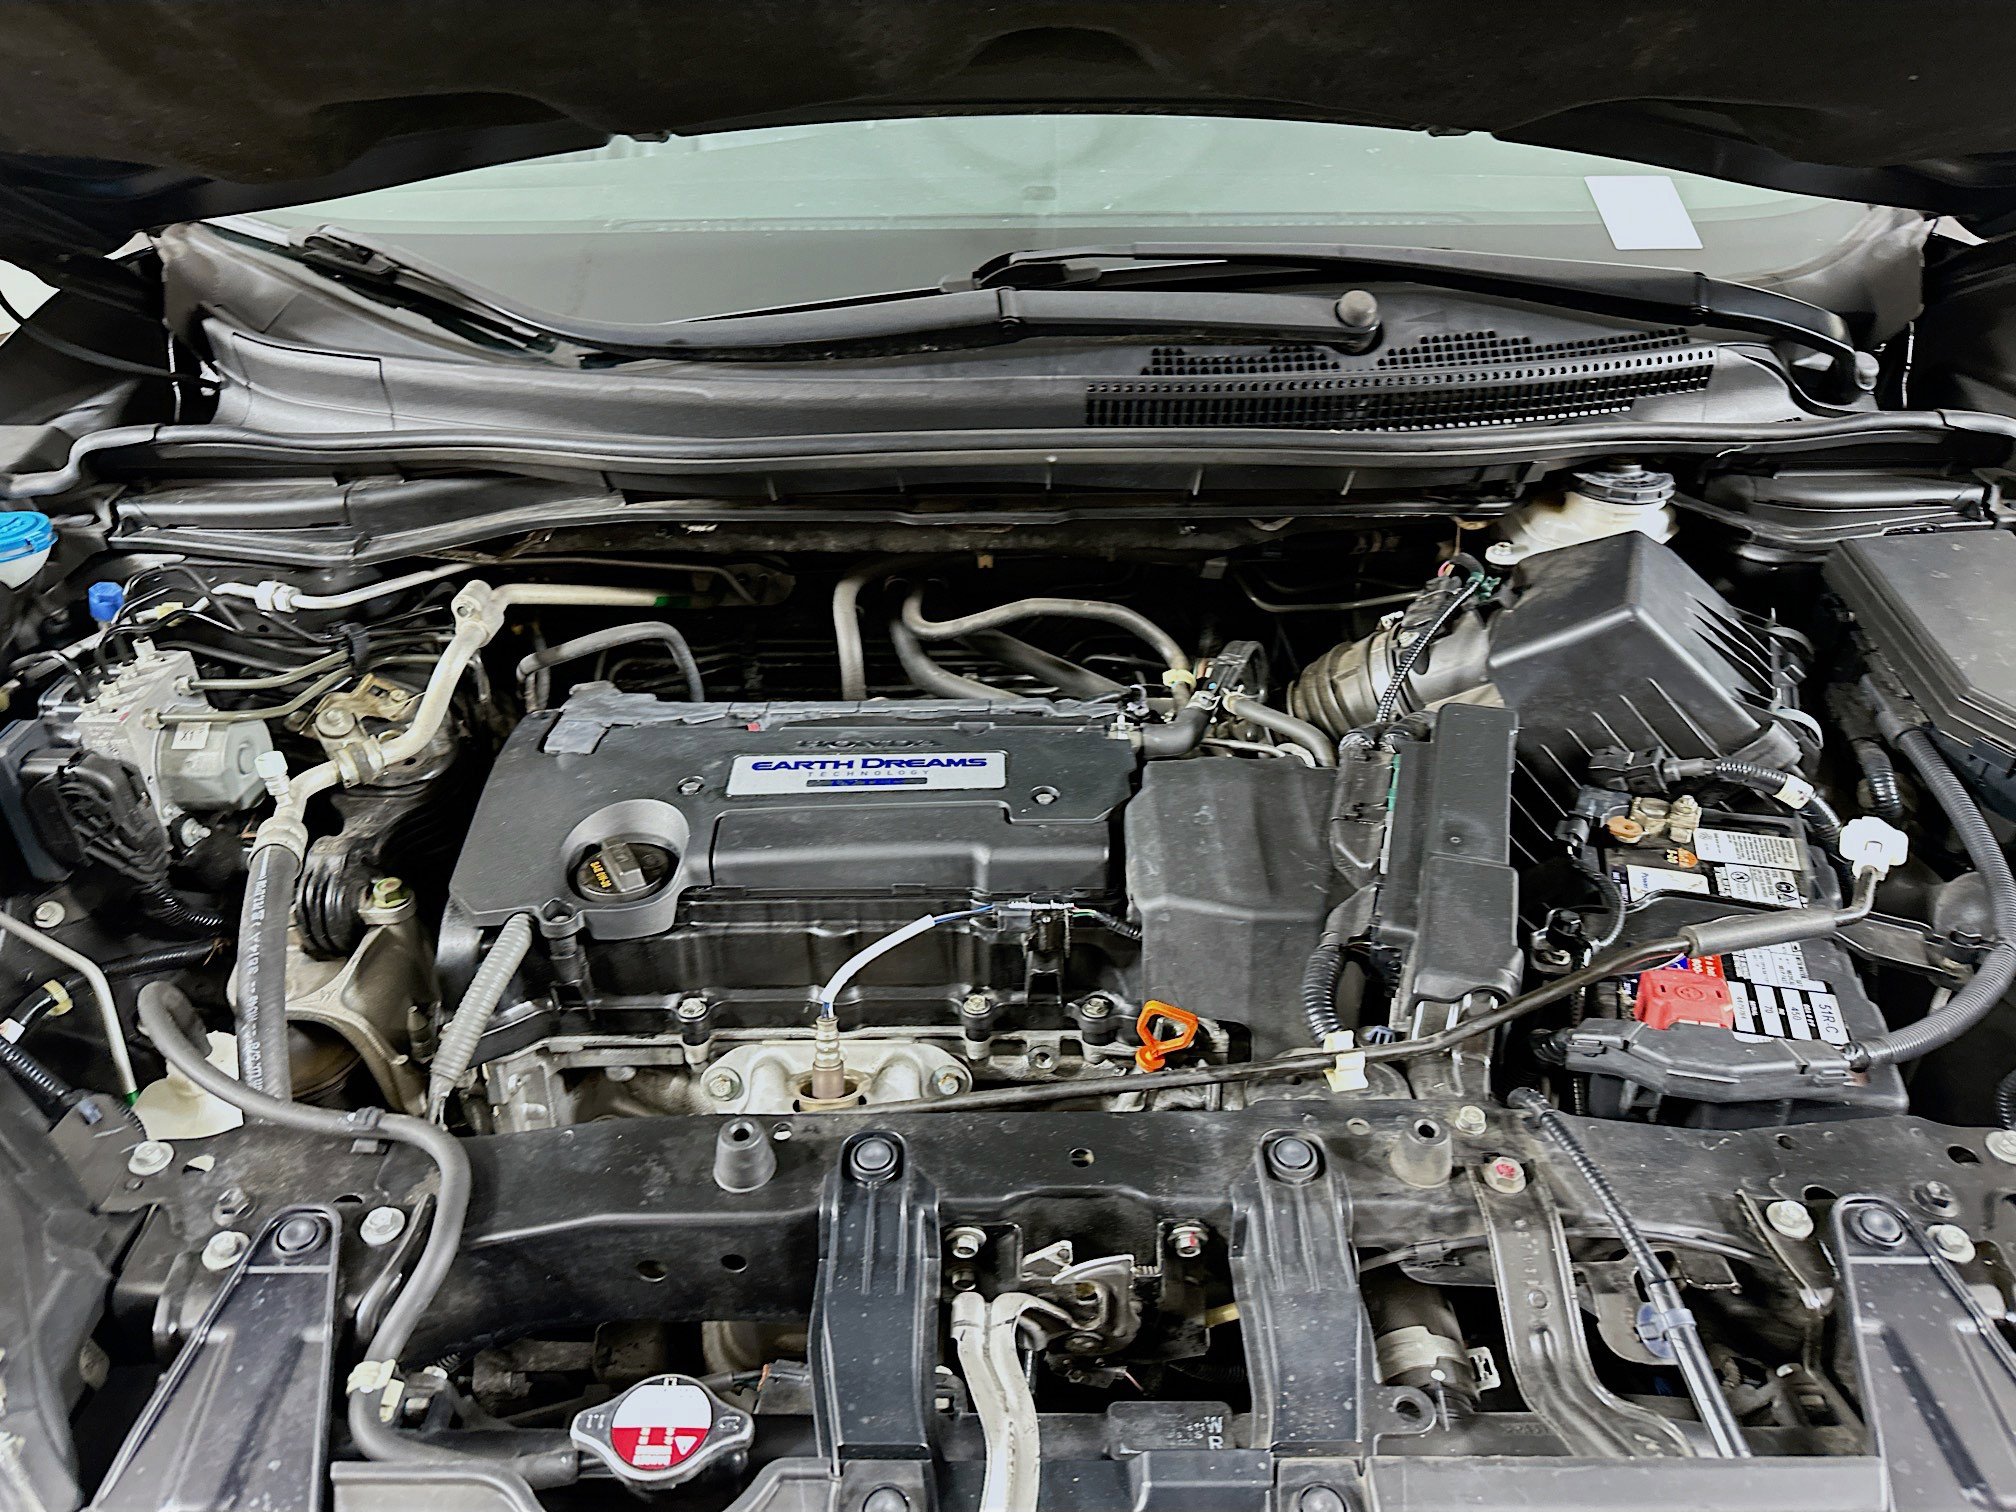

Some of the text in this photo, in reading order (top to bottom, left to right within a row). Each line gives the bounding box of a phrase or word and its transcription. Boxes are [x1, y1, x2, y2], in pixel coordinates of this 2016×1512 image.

[751, 757, 988, 771] EARTH DREAMS
[807, 769, 930, 778] TECHNOLOGY
[1818, 1003, 1839, 1035] 51R-C
